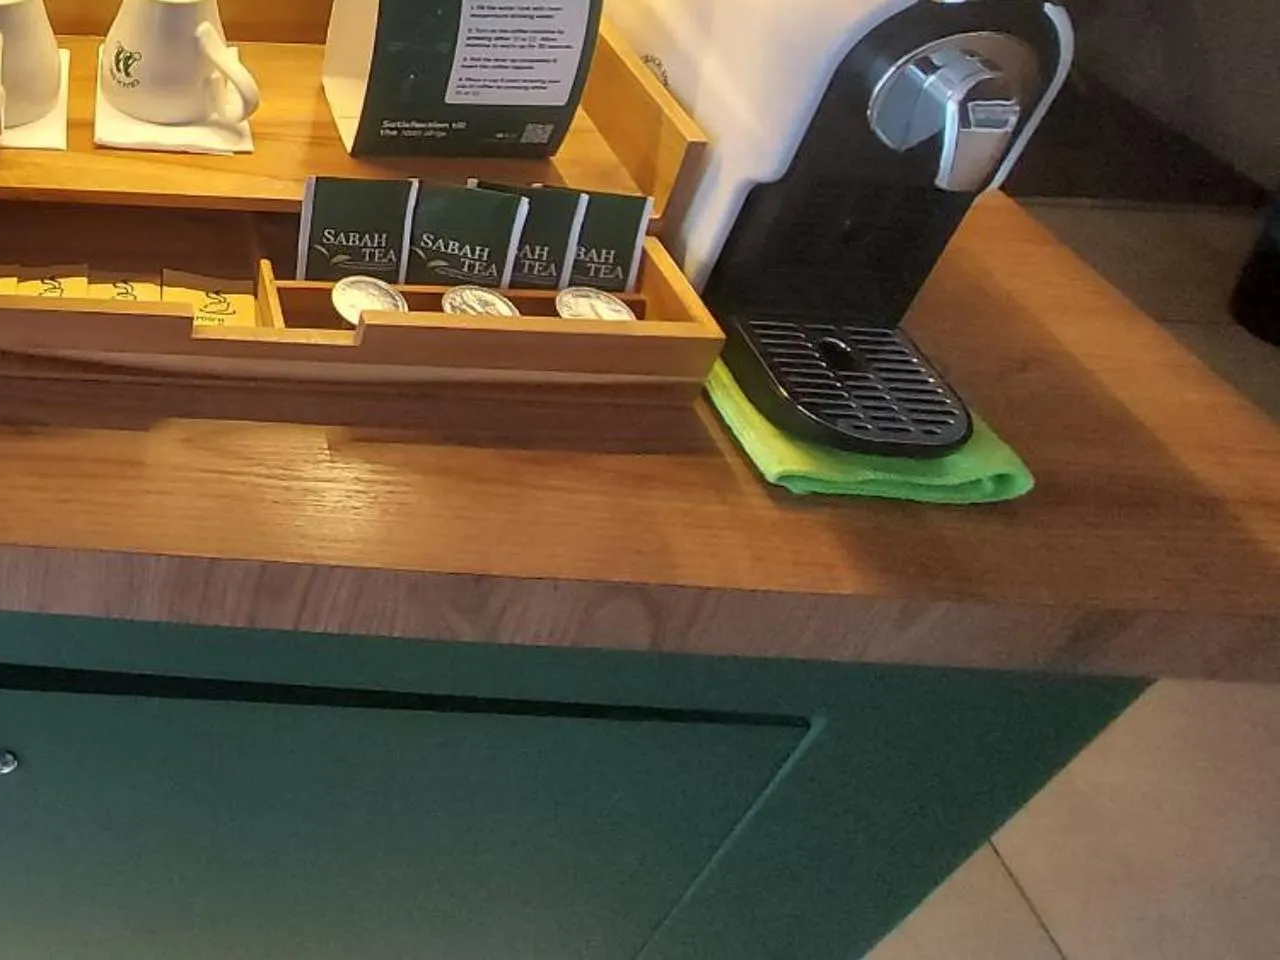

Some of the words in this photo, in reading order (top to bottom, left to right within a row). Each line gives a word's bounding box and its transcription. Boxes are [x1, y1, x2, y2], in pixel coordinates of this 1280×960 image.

[322, 228, 387, 248] SABAH
[420, 232, 490, 260] SABAH
[361, 246, 397, 263] TEA
[575, 245, 616, 263] BAH
[460, 257, 498, 277] TEA
[520, 259, 558, 277] TEA
[587, 262, 625, 280] TEA
